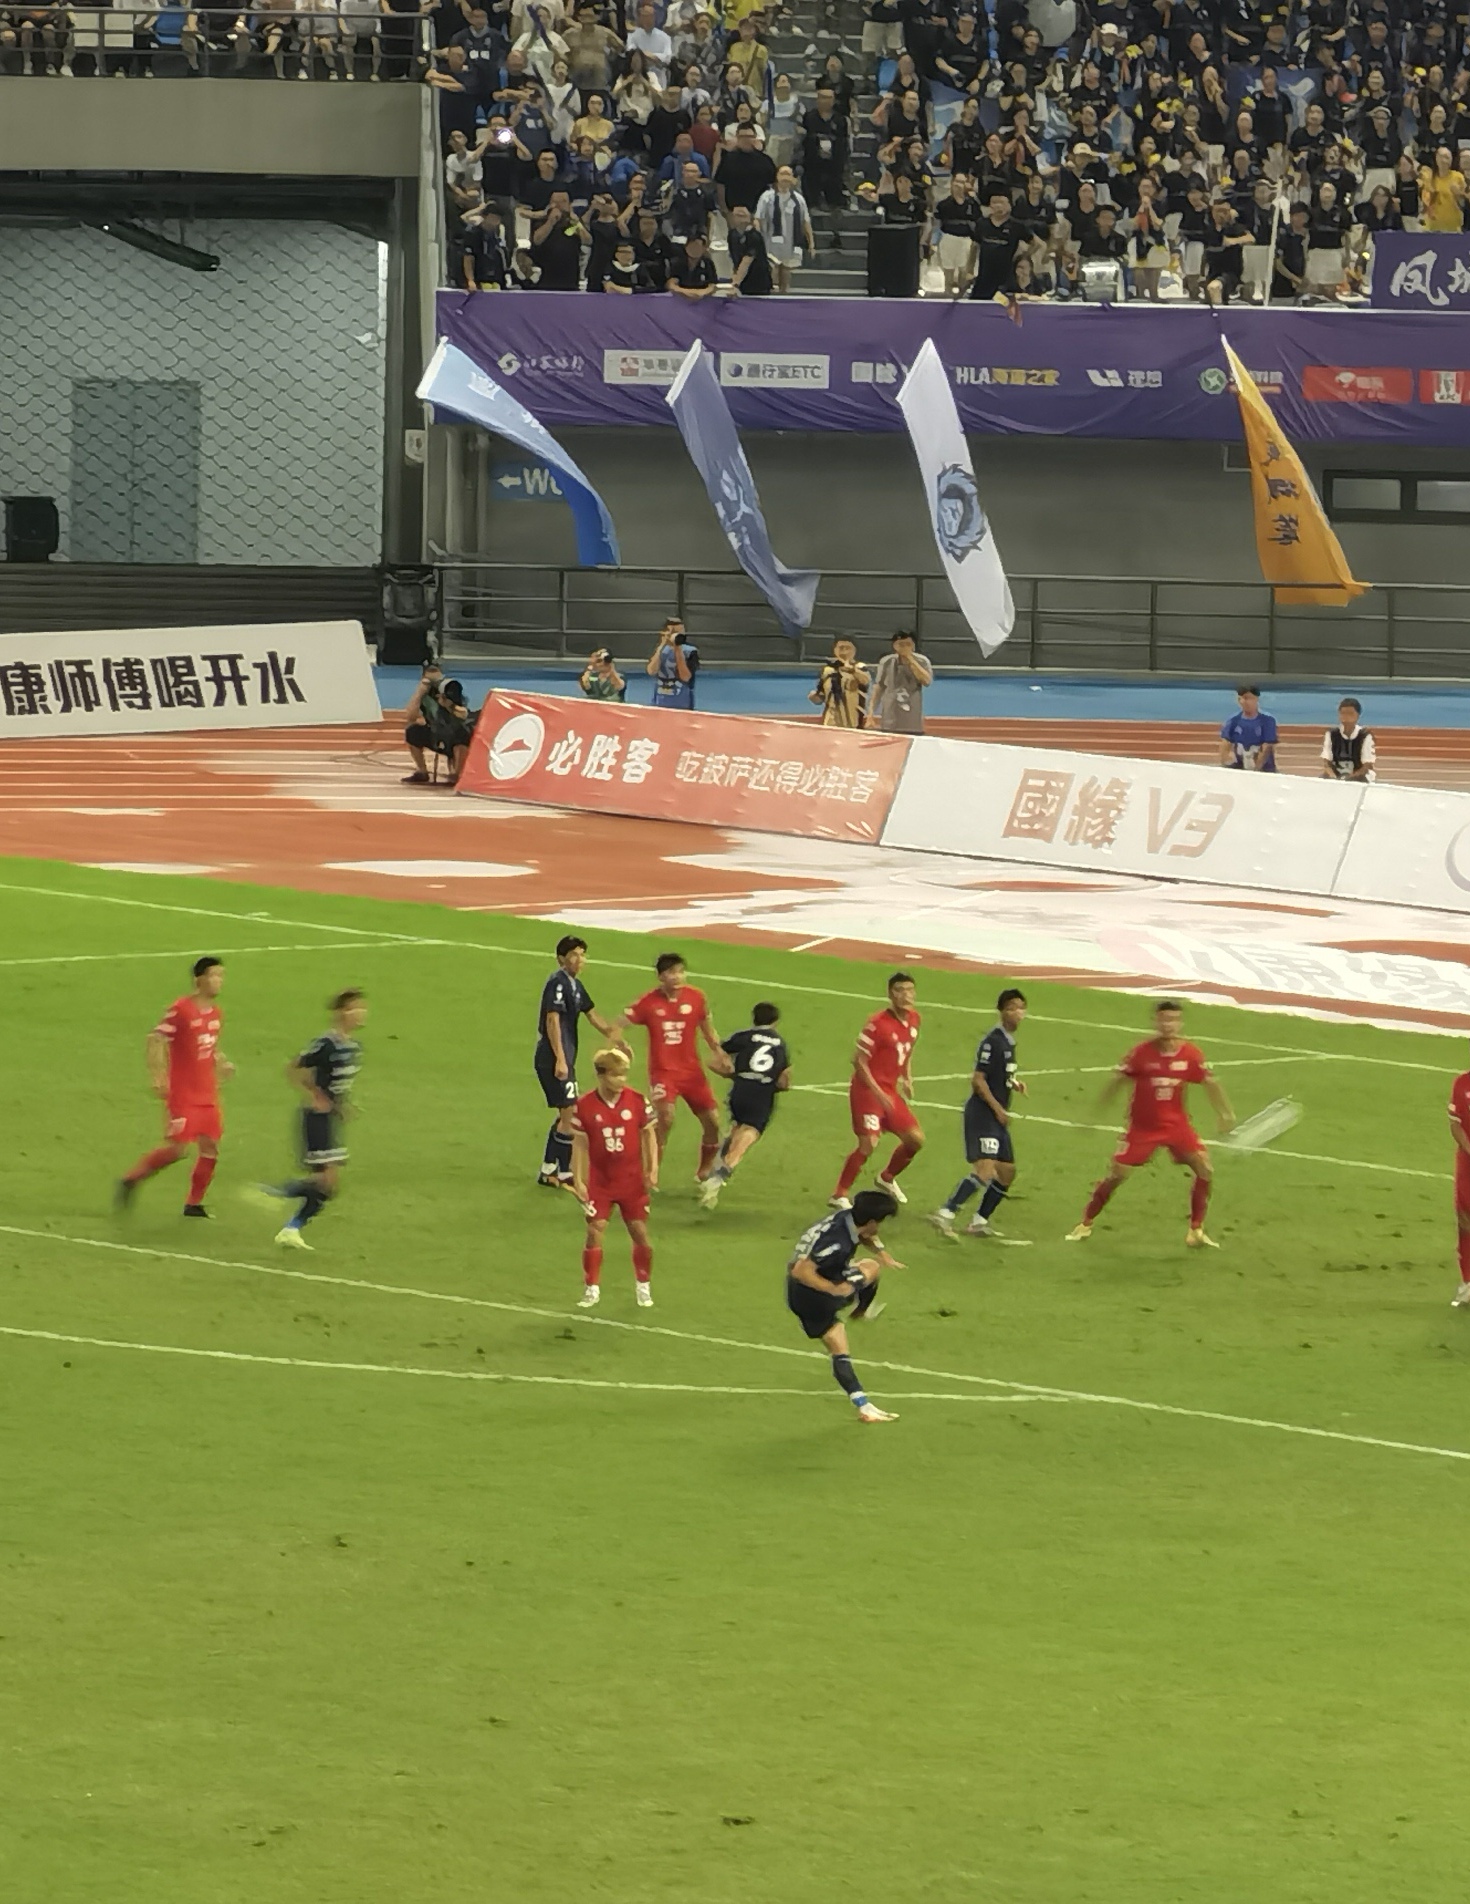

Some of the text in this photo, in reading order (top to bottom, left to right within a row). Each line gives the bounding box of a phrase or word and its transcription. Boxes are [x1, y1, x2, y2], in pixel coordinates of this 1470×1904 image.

[0, 651, 307, 717] 康师傅喝开水
[545, 730, 659, 785] 必胜客
[749, 1044, 774, 1072] 6
